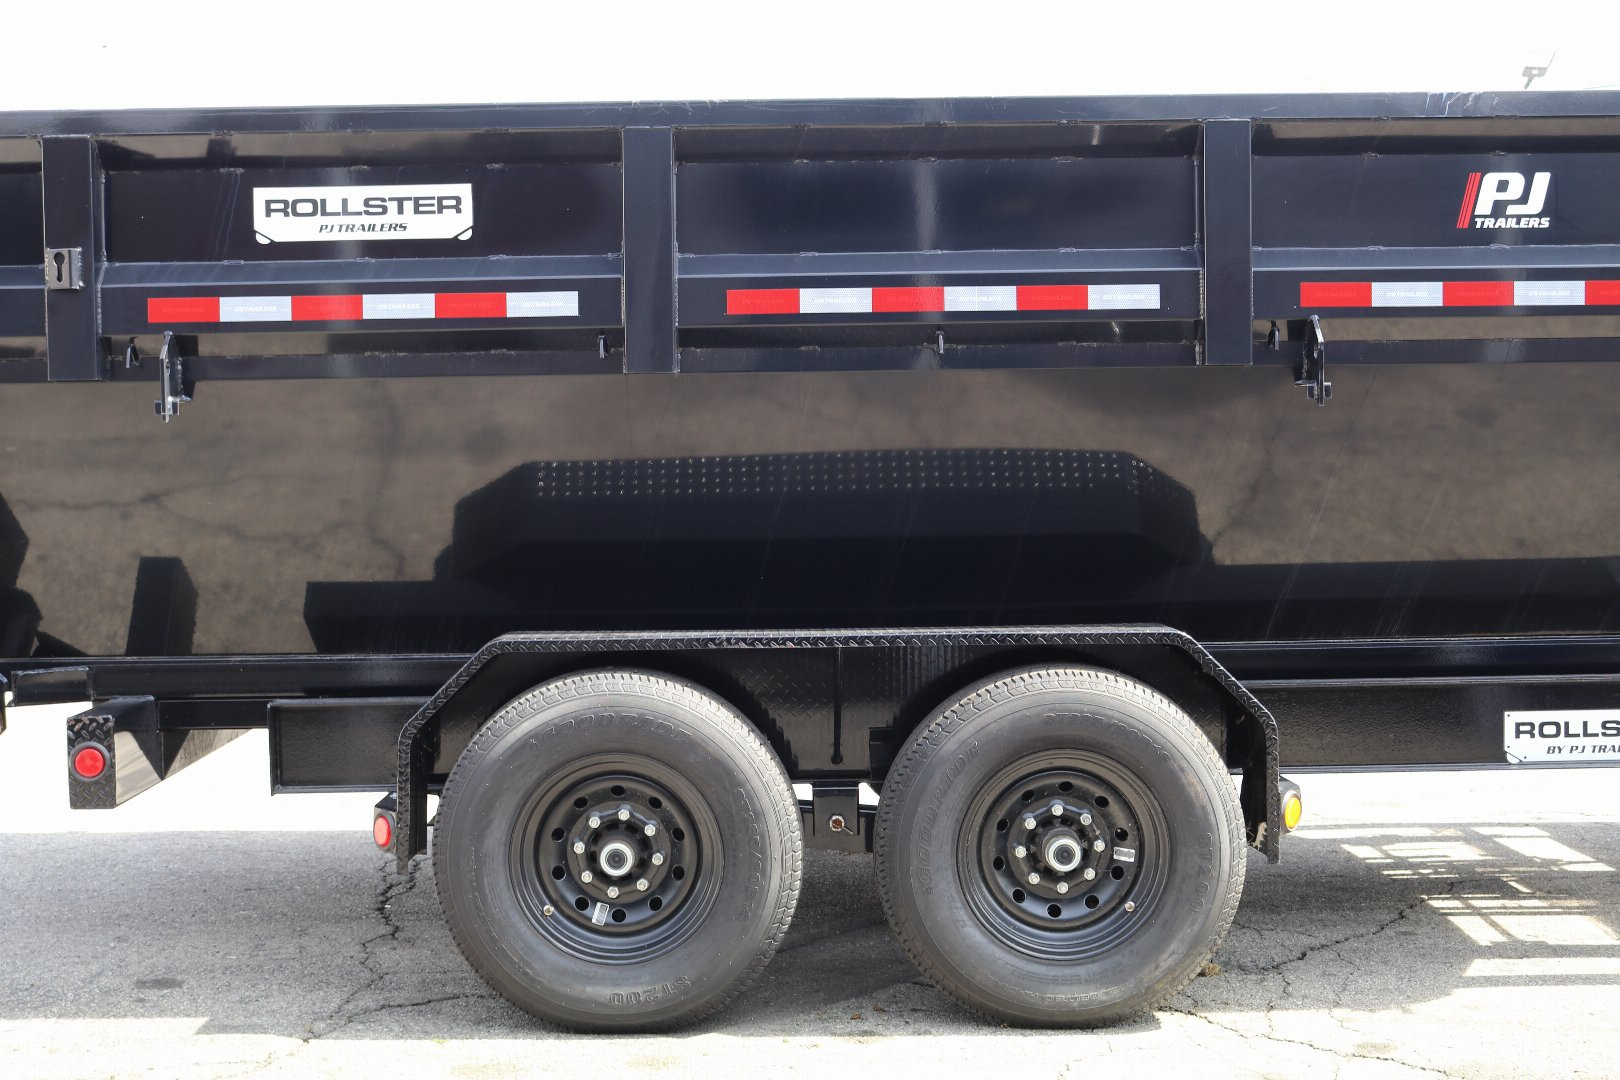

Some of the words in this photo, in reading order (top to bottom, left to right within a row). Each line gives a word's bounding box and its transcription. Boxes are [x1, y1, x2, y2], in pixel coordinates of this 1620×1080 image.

[1474, 171, 1551, 215] PJ
[265, 195, 463, 218] ROLLSTER
[337, 222, 408, 233] TRAILERS
[1474, 217, 1551, 229] TRAILERS
[1514, 719, 1620, 739] ROLLS
[1546, 745, 1566, 754] BY
[1569, 745, 1586, 754] PJ
